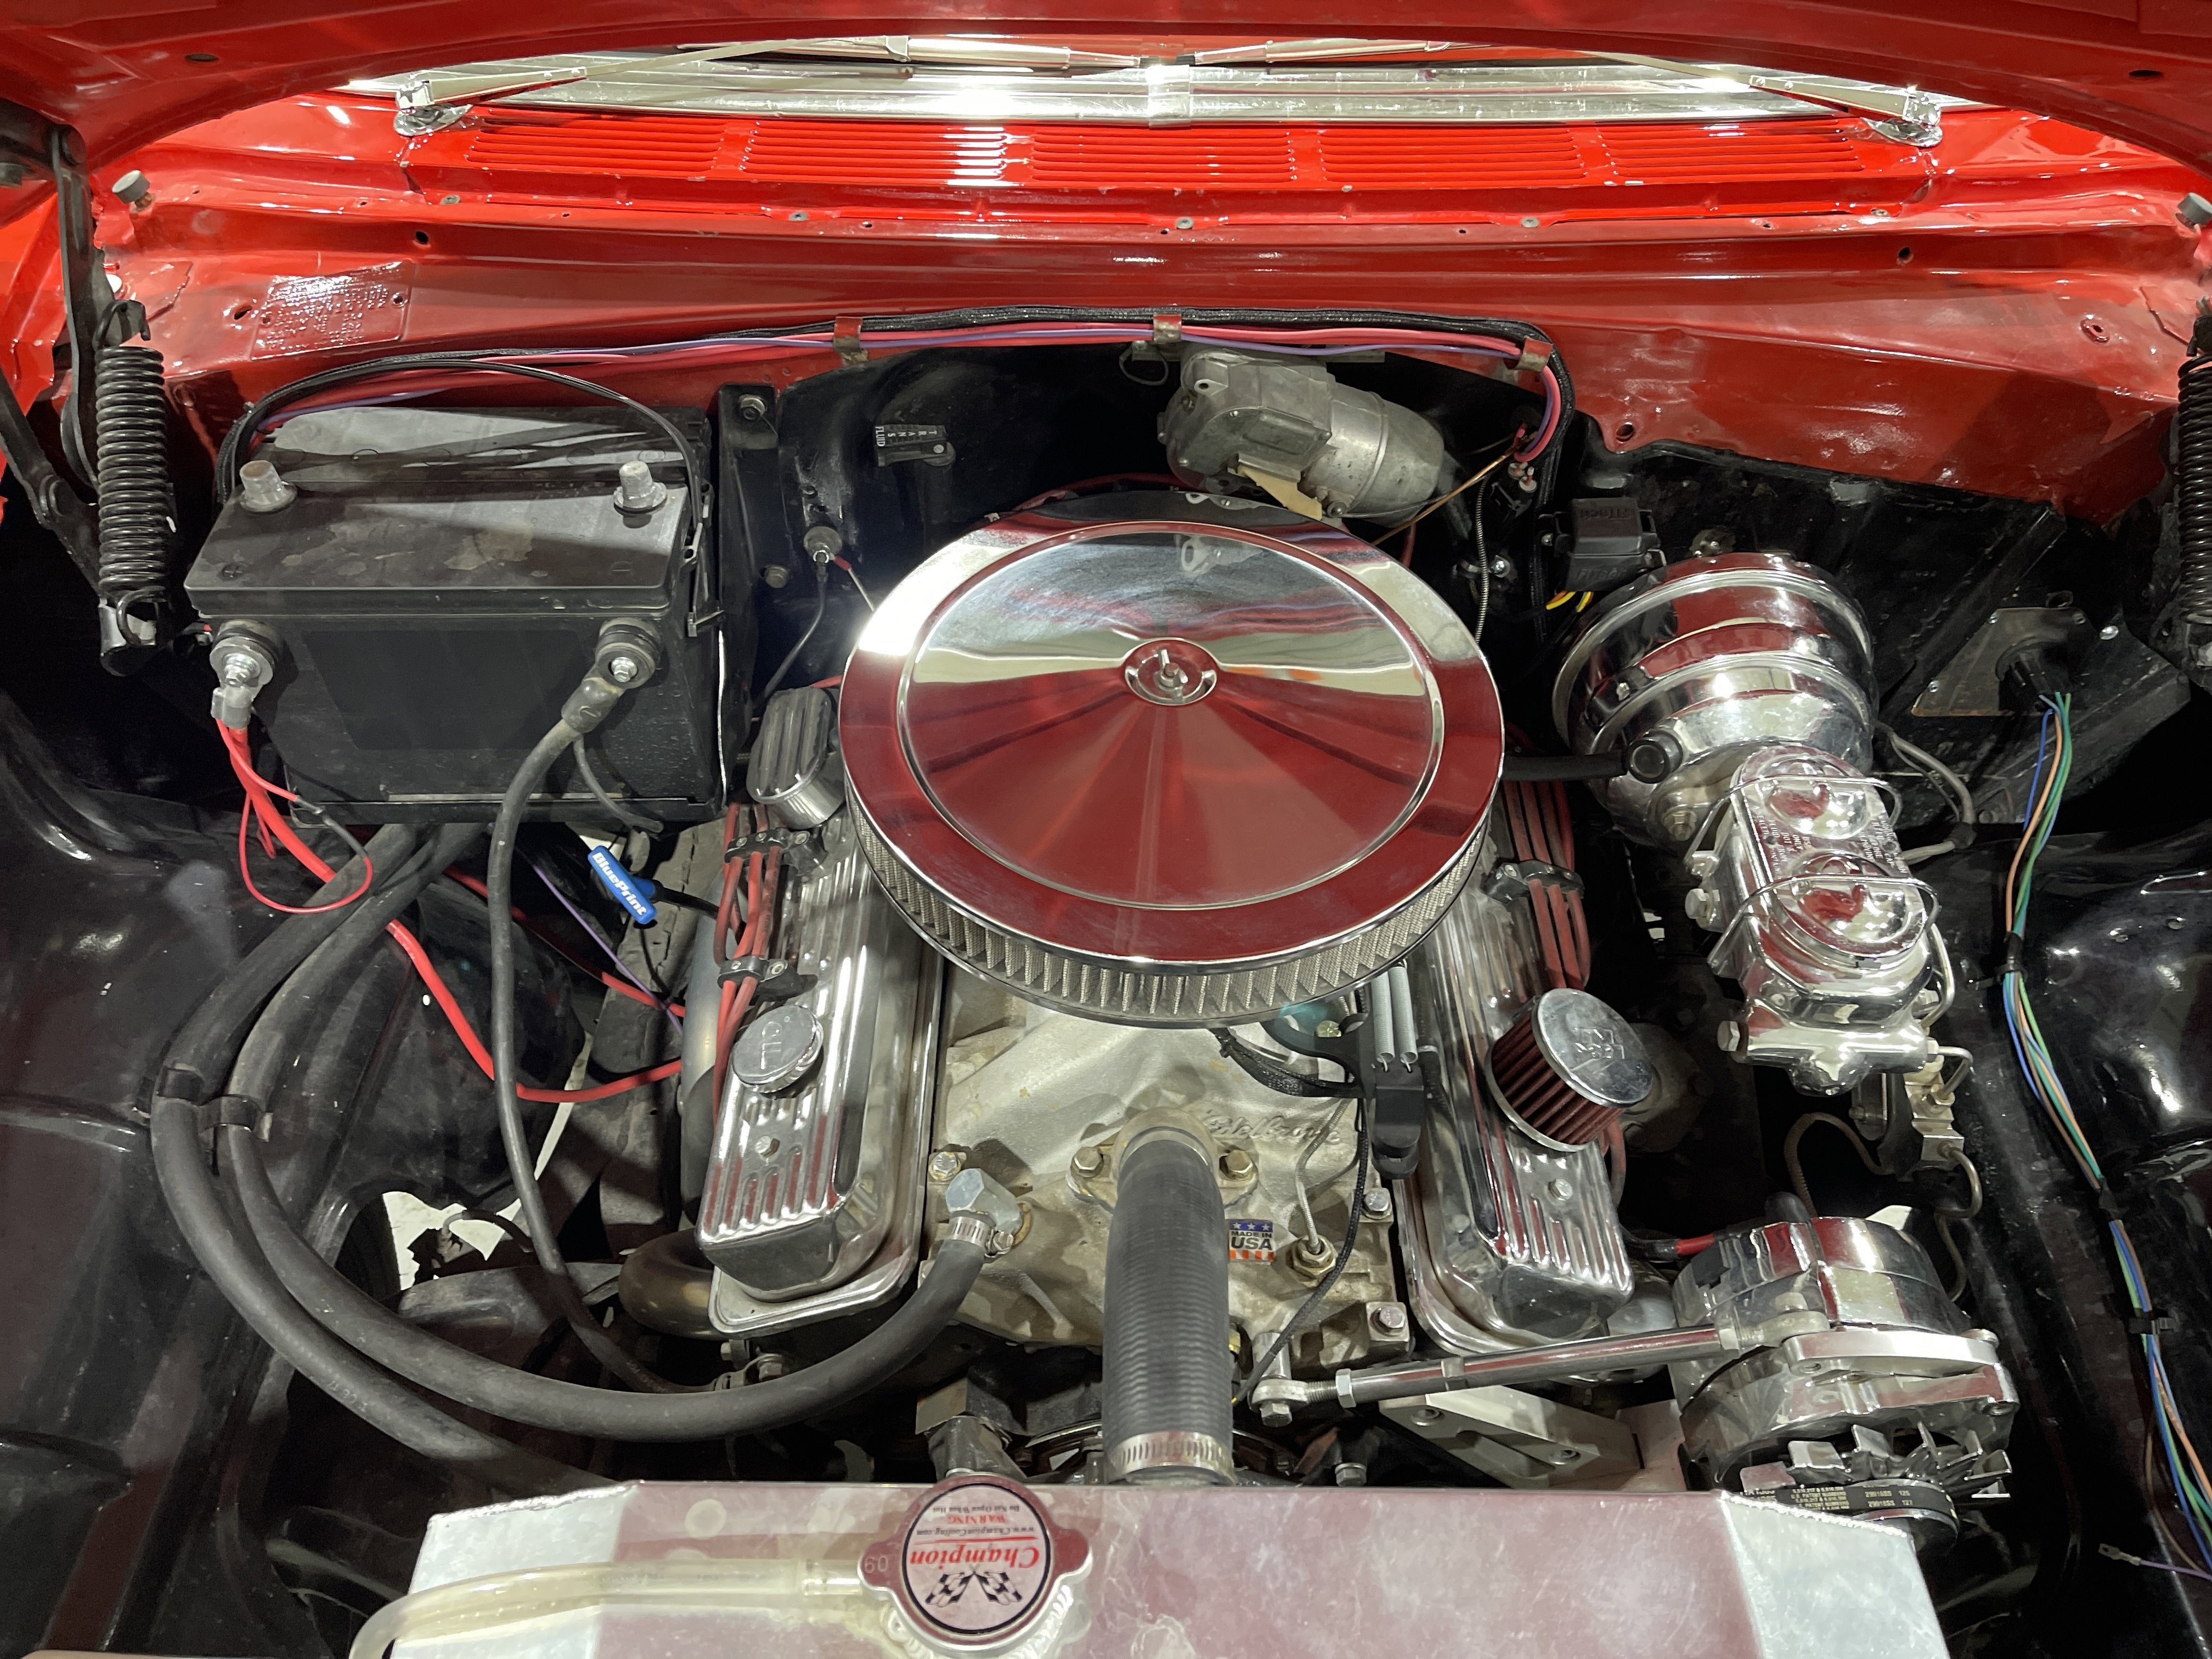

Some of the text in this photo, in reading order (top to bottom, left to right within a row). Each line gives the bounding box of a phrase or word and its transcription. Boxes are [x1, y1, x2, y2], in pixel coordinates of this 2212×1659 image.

[875, 426, 885, 447] FLUID
[888, 430, 937, 438] TRANS
[1792, 835, 1804, 850] ONLY
[1231, 1237, 1272, 1251] USA
[949, 1506, 970, 1514] When
[972, 1505, 992, 1513] Open
[1009, 1504, 1020, 1513] Do
[947, 1514, 1007, 1525] WARNING
[910, 1545, 1040, 1571] Champion
